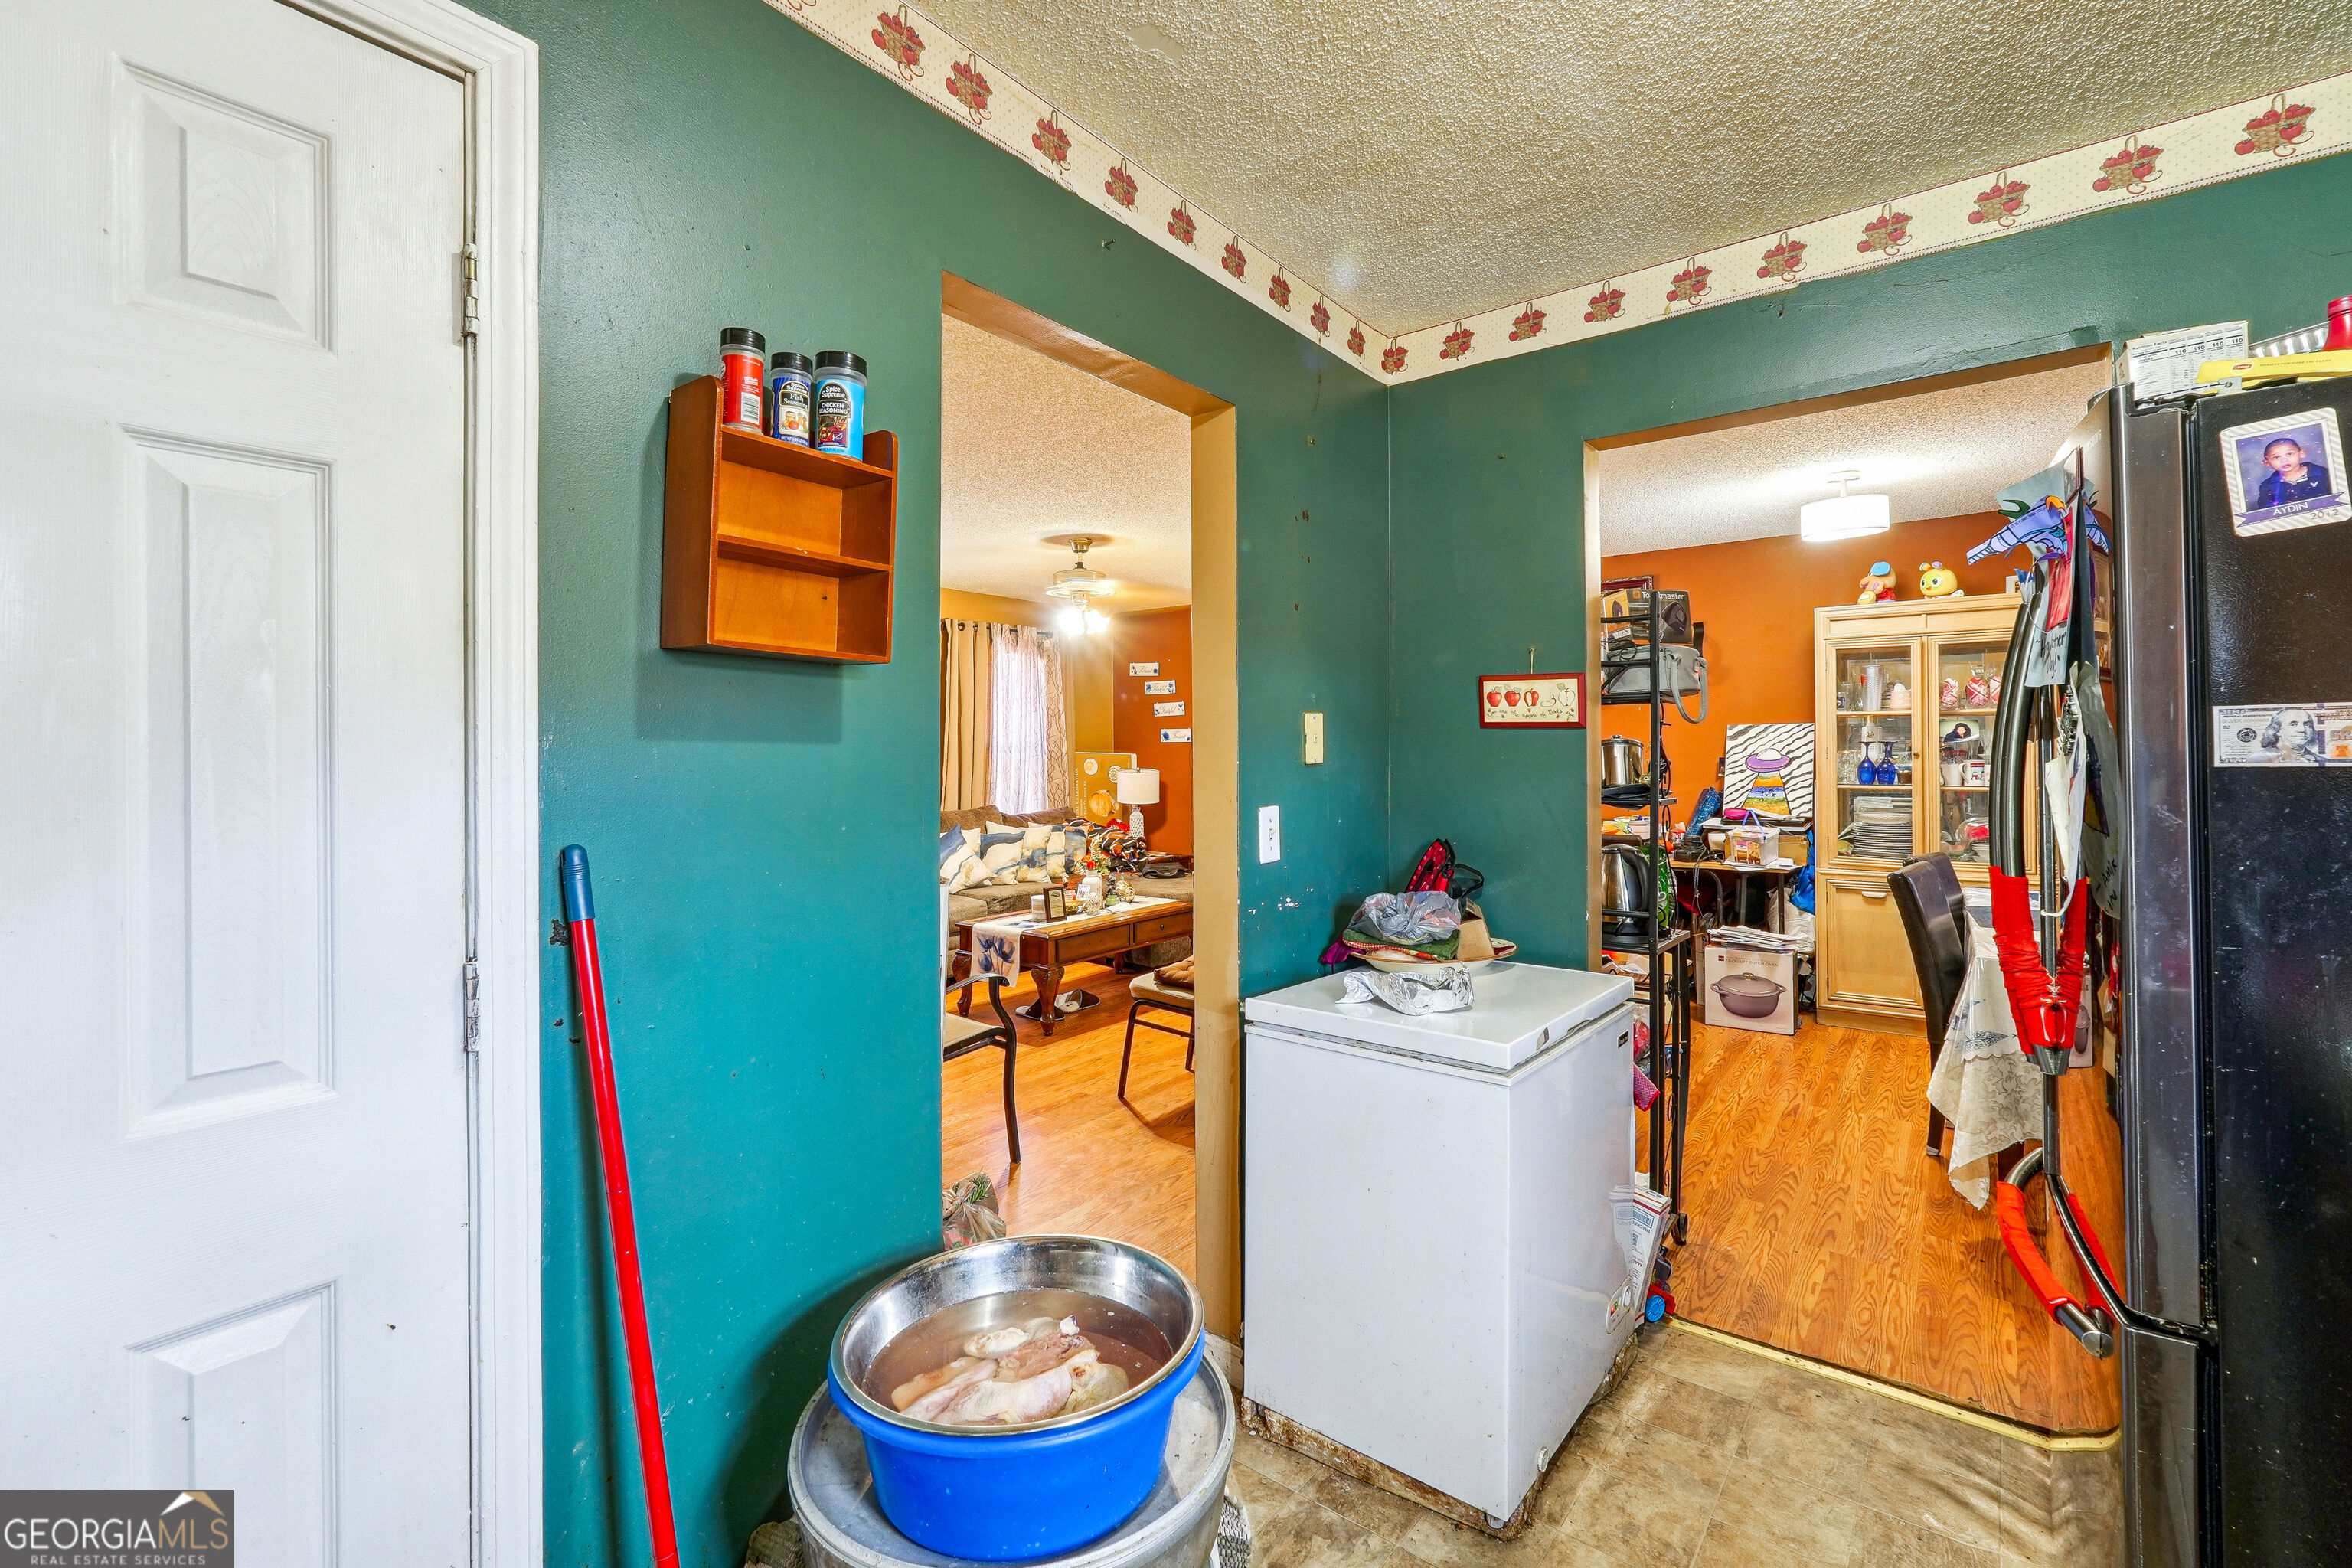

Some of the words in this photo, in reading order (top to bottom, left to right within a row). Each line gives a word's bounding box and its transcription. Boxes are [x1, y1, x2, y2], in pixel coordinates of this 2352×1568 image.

[786, 385, 808, 394] Supreme
[783, 397, 808, 410] Seasoning
[790, 393, 804, 403] Fish
[2273, 501, 2308, 516] AYDIN
[2311, 508, 2340, 520] 2012
[1641, 591, 1685, 600] Totmaster
